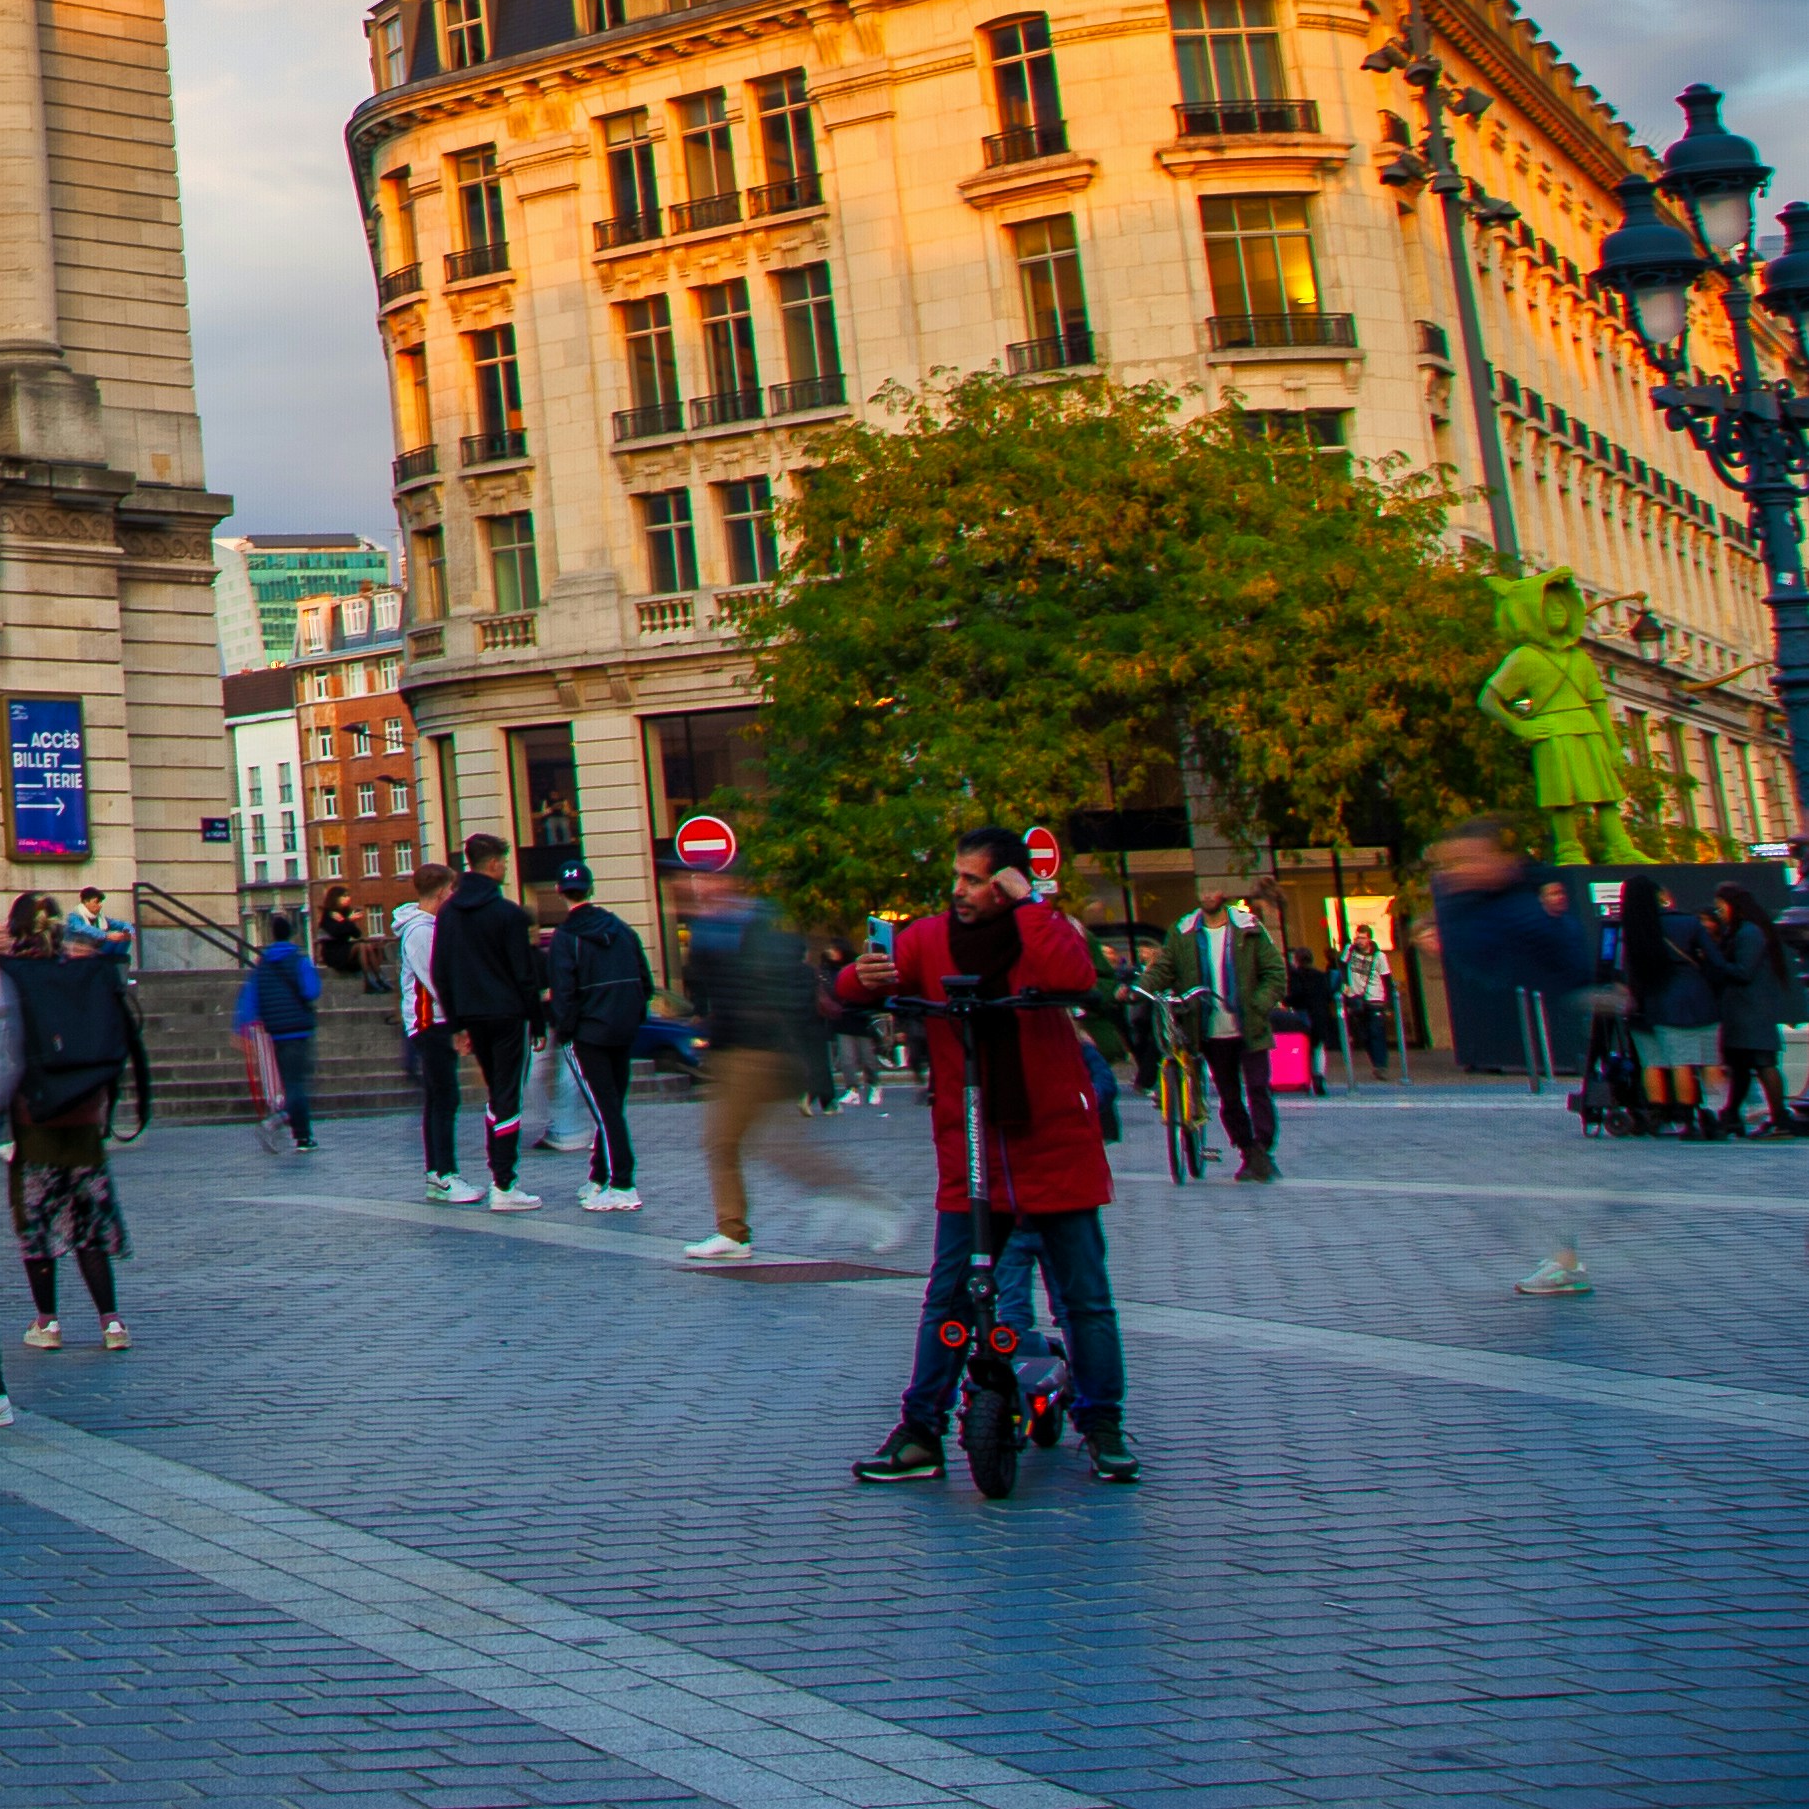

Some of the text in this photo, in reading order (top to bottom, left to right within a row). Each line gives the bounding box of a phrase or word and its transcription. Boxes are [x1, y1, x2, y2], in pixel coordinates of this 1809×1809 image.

[30, 729, 81, 749] ACCÈS
[13, 752, 61, 768] BILLET
[43, 772, 83, 789] TERIE
